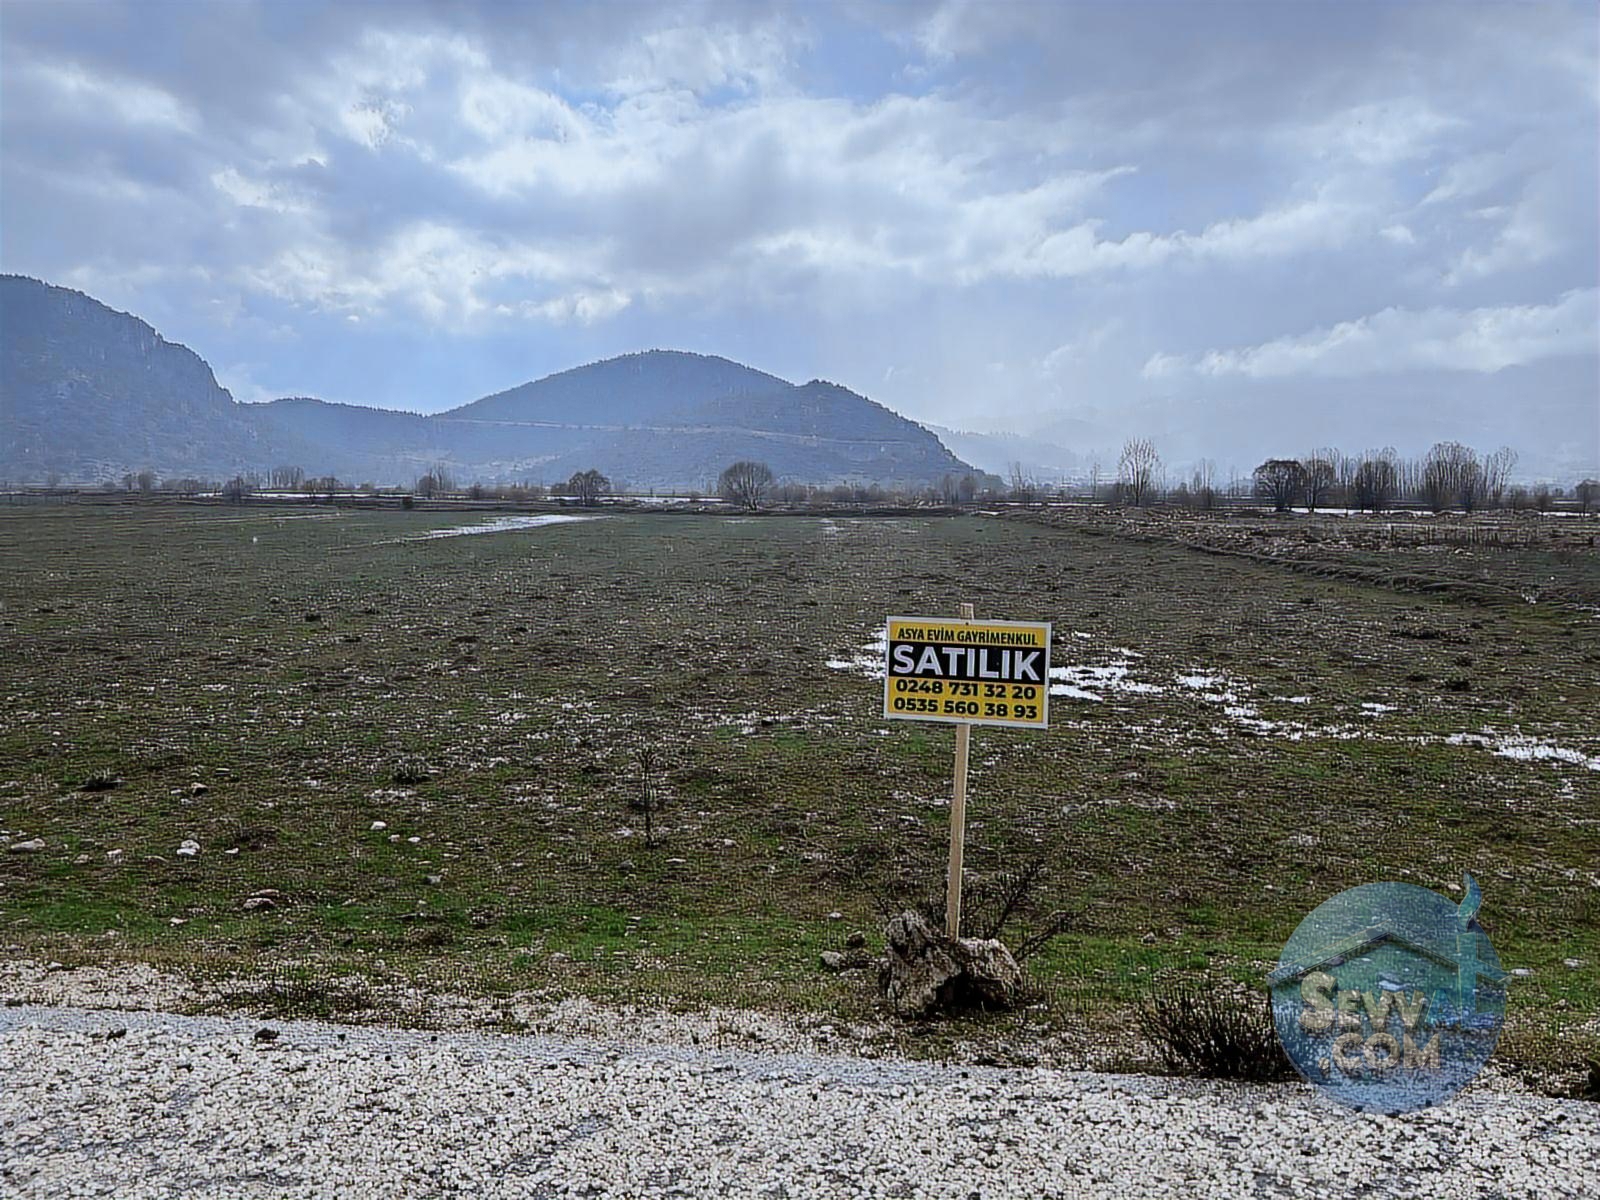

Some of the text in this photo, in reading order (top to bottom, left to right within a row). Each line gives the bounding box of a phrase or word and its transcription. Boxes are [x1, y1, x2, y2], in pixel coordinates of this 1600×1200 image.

[898, 627, 1038, 645] ASYA EVİM GAYRİMENKUL
[893, 645, 1040, 681] SATILIK
[896, 680, 1036, 699] 0248 731 32 20
[894, 697, 1037, 719] 0535 560 38 93
